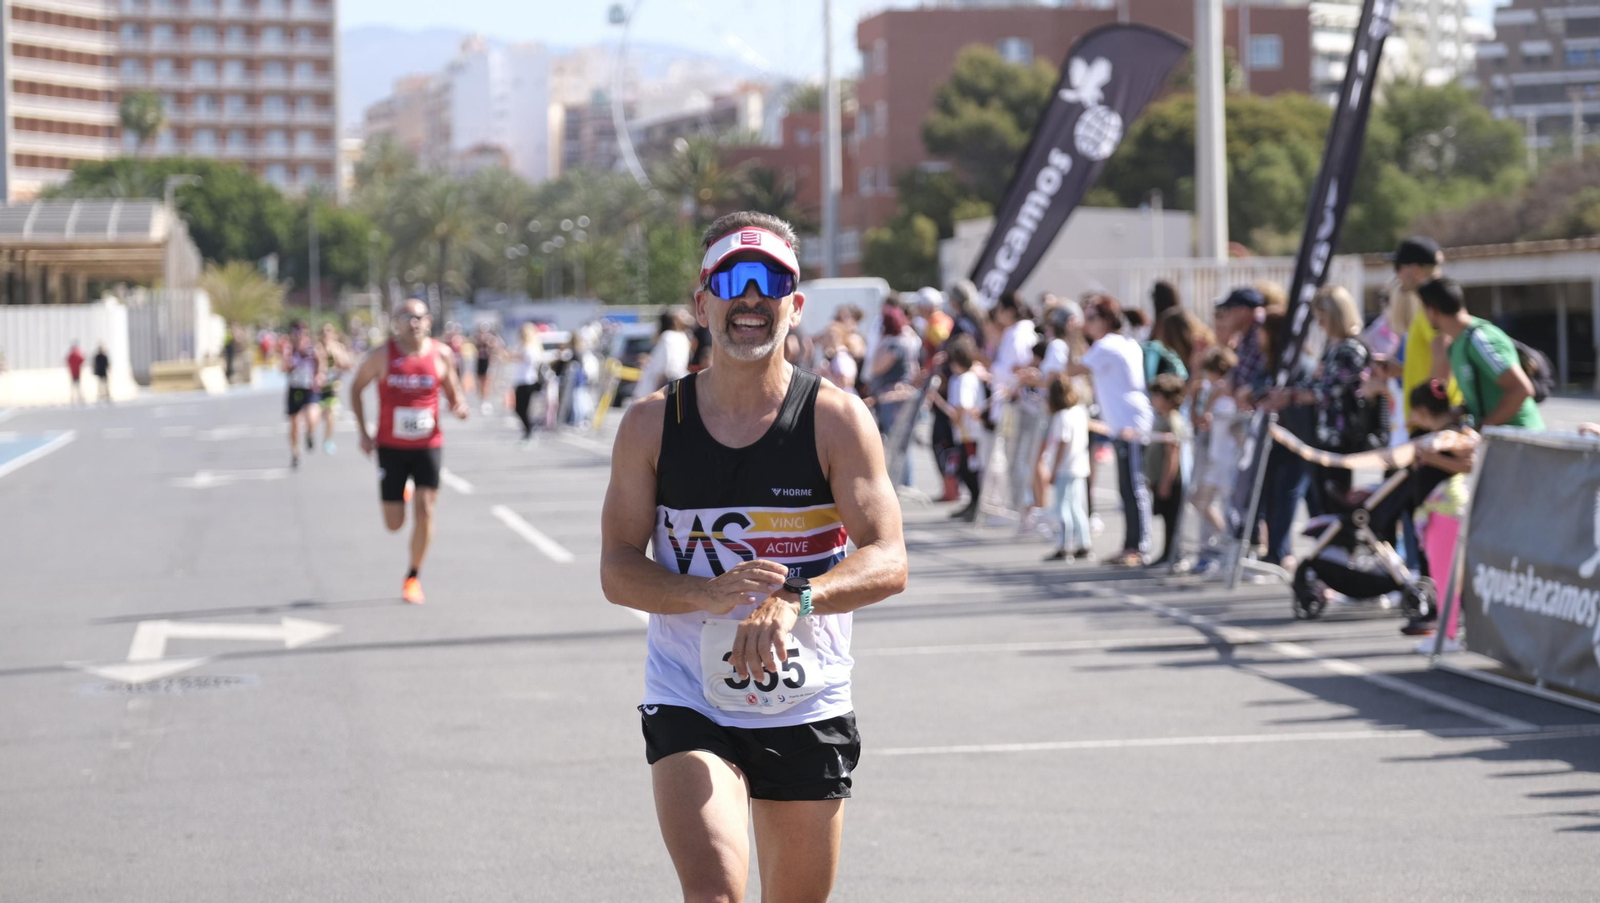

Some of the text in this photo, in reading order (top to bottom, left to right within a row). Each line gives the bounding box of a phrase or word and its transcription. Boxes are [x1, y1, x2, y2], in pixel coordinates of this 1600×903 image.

[782, 488, 812, 497] HORME
[770, 517, 806, 529] VINCI
[765, 541, 809, 554] ACTIVE
